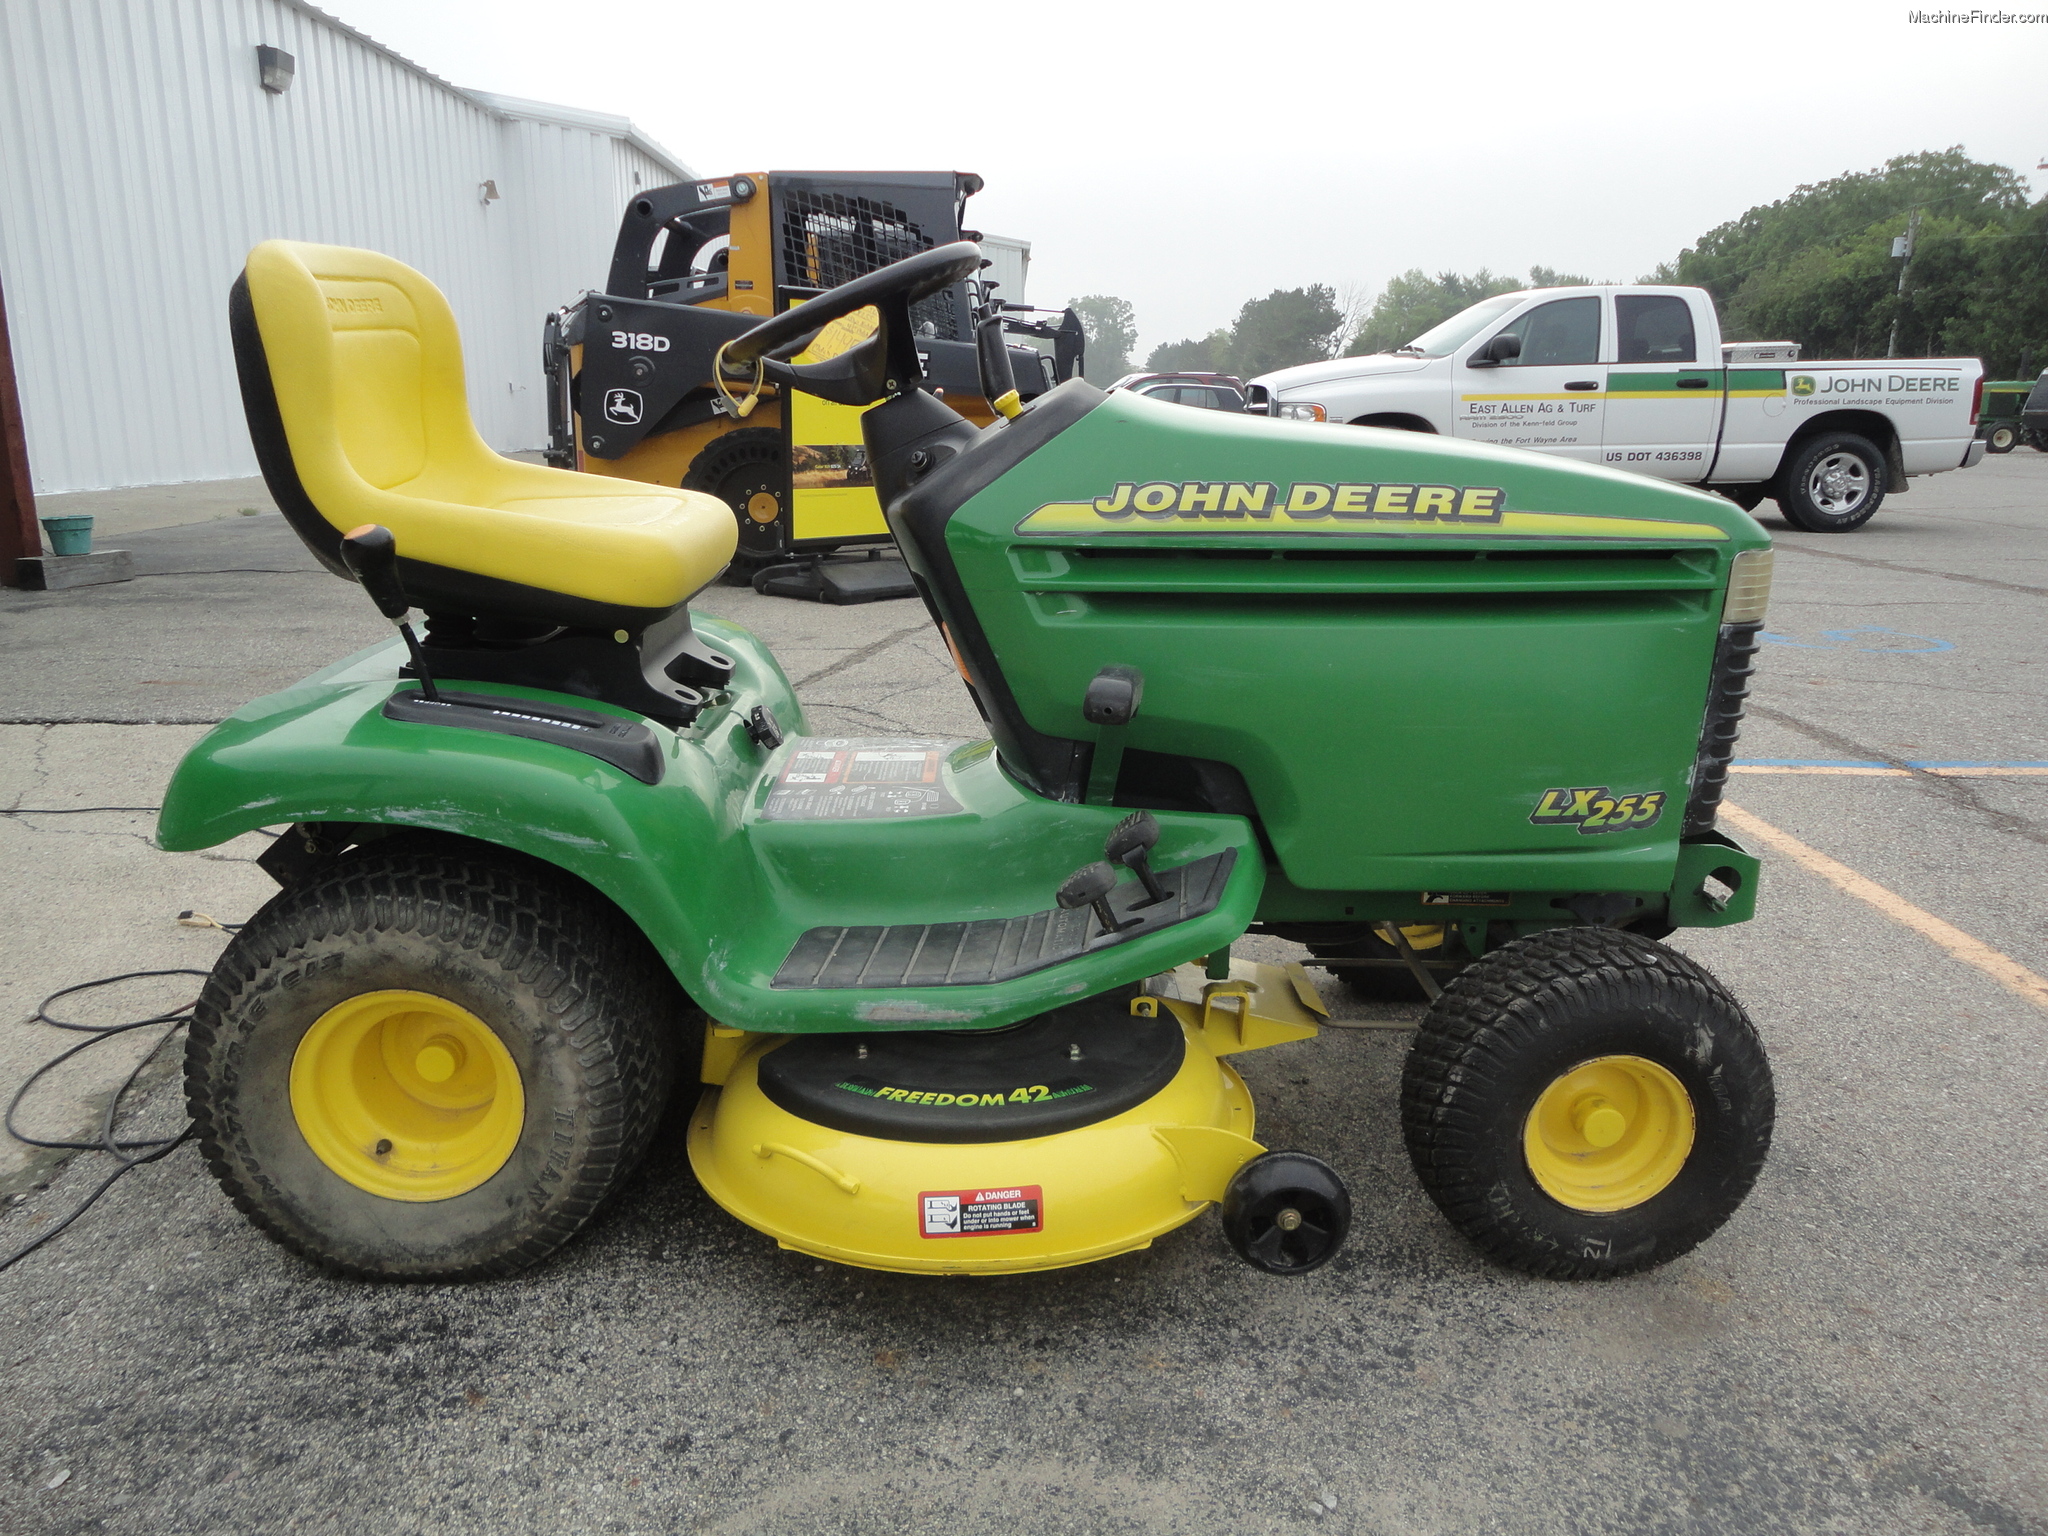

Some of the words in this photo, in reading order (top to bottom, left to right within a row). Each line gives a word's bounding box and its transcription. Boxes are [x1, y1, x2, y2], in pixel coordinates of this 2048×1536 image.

[611, 330, 671, 352] 318D
[1821, 375, 1882, 393] JOHN
[1888, 374, 1960, 392] DEERE
[1793, 397, 1840, 405] Professional
[1842, 397, 1882, 406] Landscape
[1885, 397, 1923, 406] Equipment
[1925, 397, 1954, 405] Division
[1469, 402, 1497, 414] EAST
[1500, 402, 1534, 414] ALLEN
[1537, 402, 1553, 413] AG
[1557, 403, 1564, 413] &
[1568, 401, 1597, 413] TURF
[1557, 419, 1578, 427] Group
[1533, 436, 1558, 445] Wayne
[1605, 452, 1623, 462] US
[1627, 452, 1652, 461] DOT
[1655, 451, 1703, 461] 436398
[1093, 482, 1276, 518] JOHN
[1286, 483, 1503, 521] DEERE
[873, 1086, 1005, 1107] FREEDOM
[1008, 1085, 1053, 1104] 42
[528, 1107, 576, 1212] TITAN
[985, 1190, 1021, 1200] DANGER
[968, 1203, 1002, 1212] ROTATING
[1003, 1201, 1026, 1210] BLADE
[983, 1211, 993, 1219] put
[989, 1222, 1012, 1230] running
